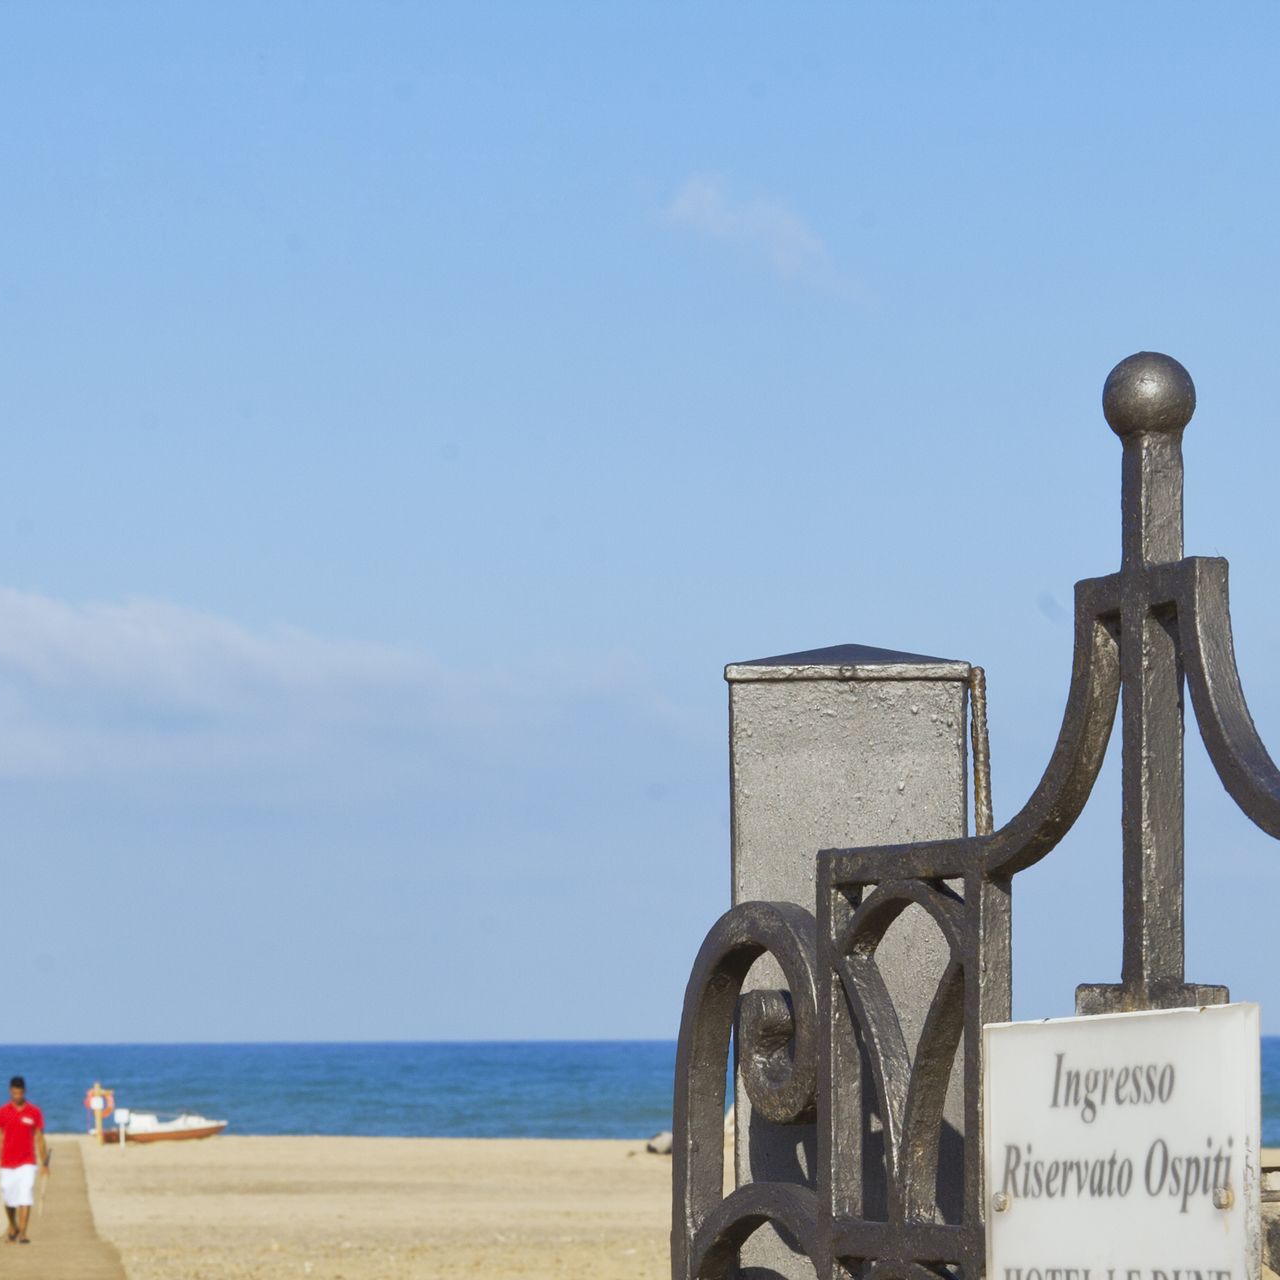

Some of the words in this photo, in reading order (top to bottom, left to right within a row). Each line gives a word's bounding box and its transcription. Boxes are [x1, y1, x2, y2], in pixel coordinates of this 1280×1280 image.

[1050, 1053, 1176, 1124] Ingresso
[1002, 1143, 1133, 1200] Riservato
[1144, 1135, 1235, 1213] Ospiti
